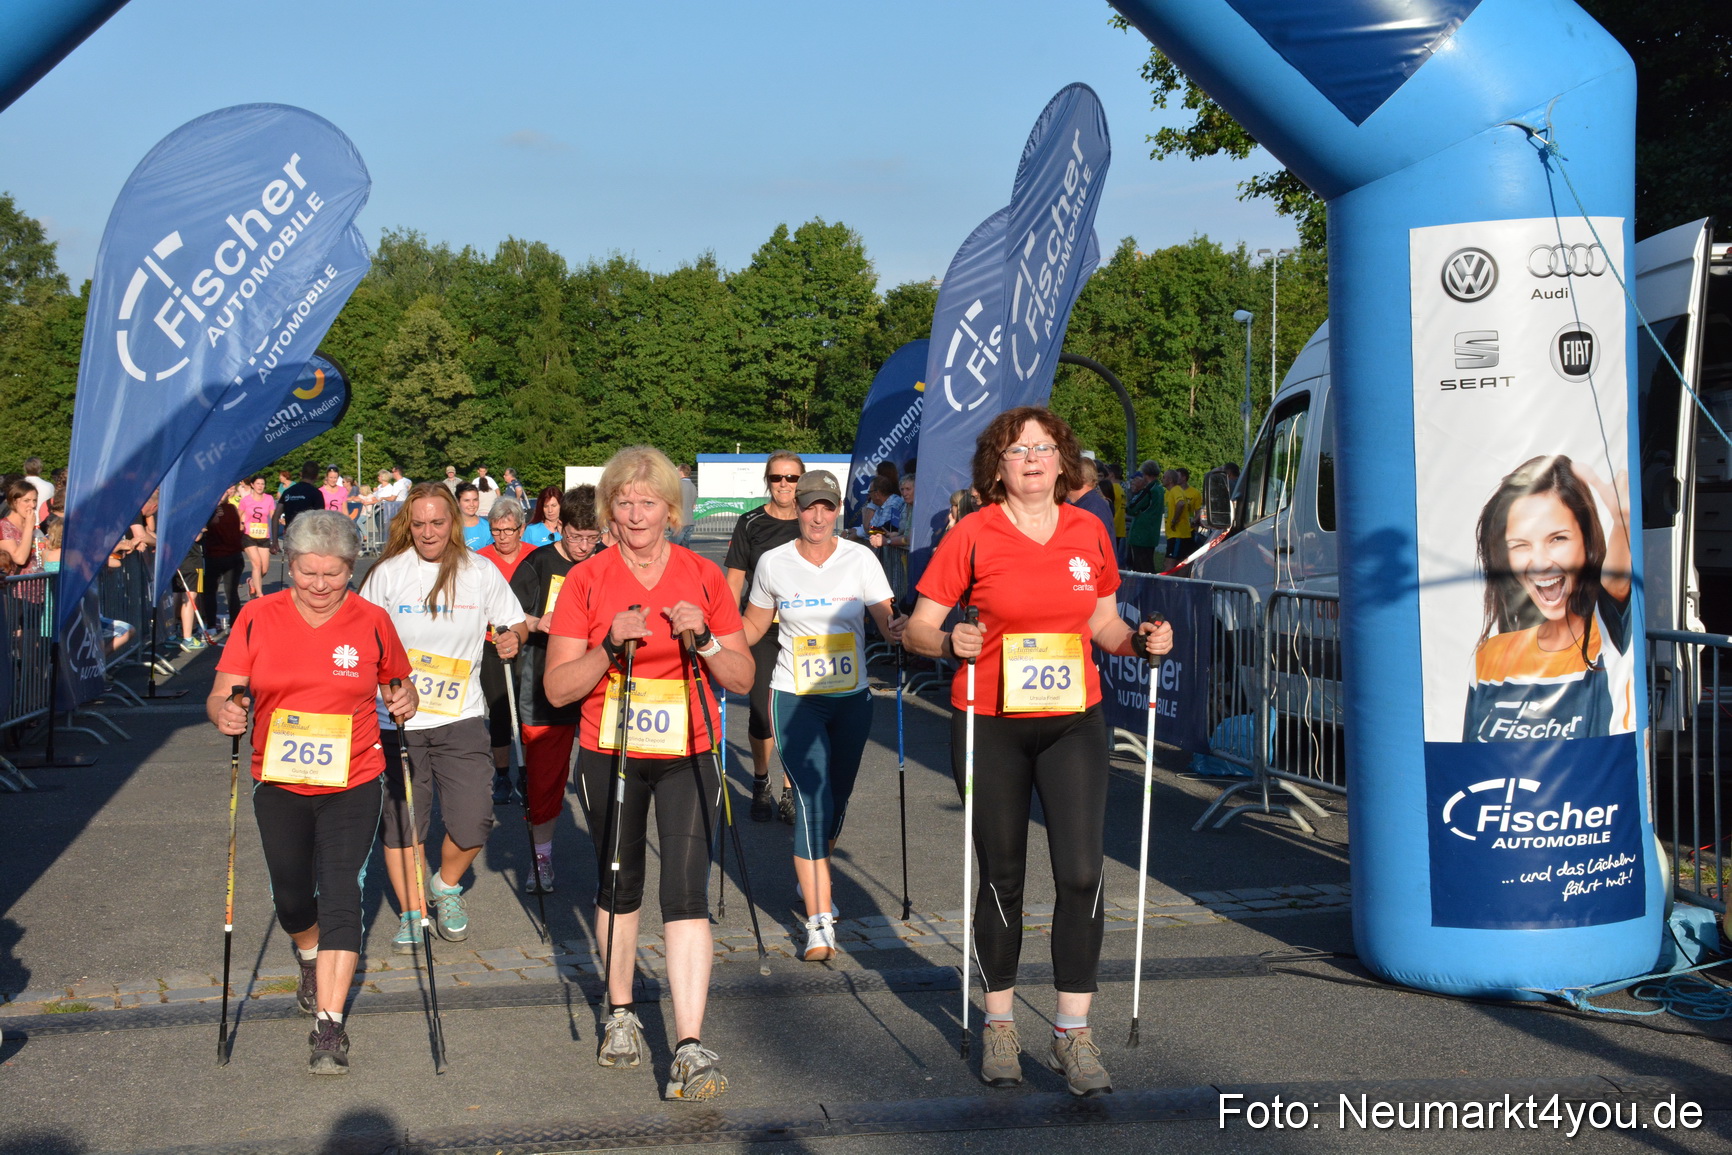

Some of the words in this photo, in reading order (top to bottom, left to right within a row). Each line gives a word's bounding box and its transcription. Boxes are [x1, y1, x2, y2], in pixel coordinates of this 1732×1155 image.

[1024, 128, 1086, 342] Fischer
[153, 152, 308, 349] Fischer
[1044, 163, 1093, 340] AUTOMOBILE
[206, 191, 325, 348] AUTOMOBILE
[1530, 288, 1569, 300] Audi
[258, 264, 338, 384] AUTOMOBILE
[1563, 339, 1591, 366] FIAT
[1440, 376, 1516, 391] SEAT
[264, 423, 292, 443] Druck
[308, 395, 341, 420] Medien
[854, 396, 925, 486] Frischmann
[1072, 583, 1095, 591] caritas
[780, 592, 833, 610] RÖDL
[332, 669, 360, 678] caritas
[801, 656, 852, 678] 1316
[1022, 665, 1071, 690] 263
[1108, 650, 1182, 692] Fiscer
[409, 674, 460, 700] 1315
[1117, 689, 1177, 718] AUTOMBILE
[618, 707, 671, 734] 260
[1489, 716, 1583, 741] Fischer
[281, 740, 333, 766] 265
[1476, 801, 1618, 833] Fischer
[1492, 831, 1611, 849] AUTOMOBILE
[1520, 865, 1552, 883] und
[1556, 860, 1585, 877] das
[1587, 852, 1636, 875] Lächeln
[1561, 879, 1603, 902] fährt
[1605, 869, 1633, 888] mit!
